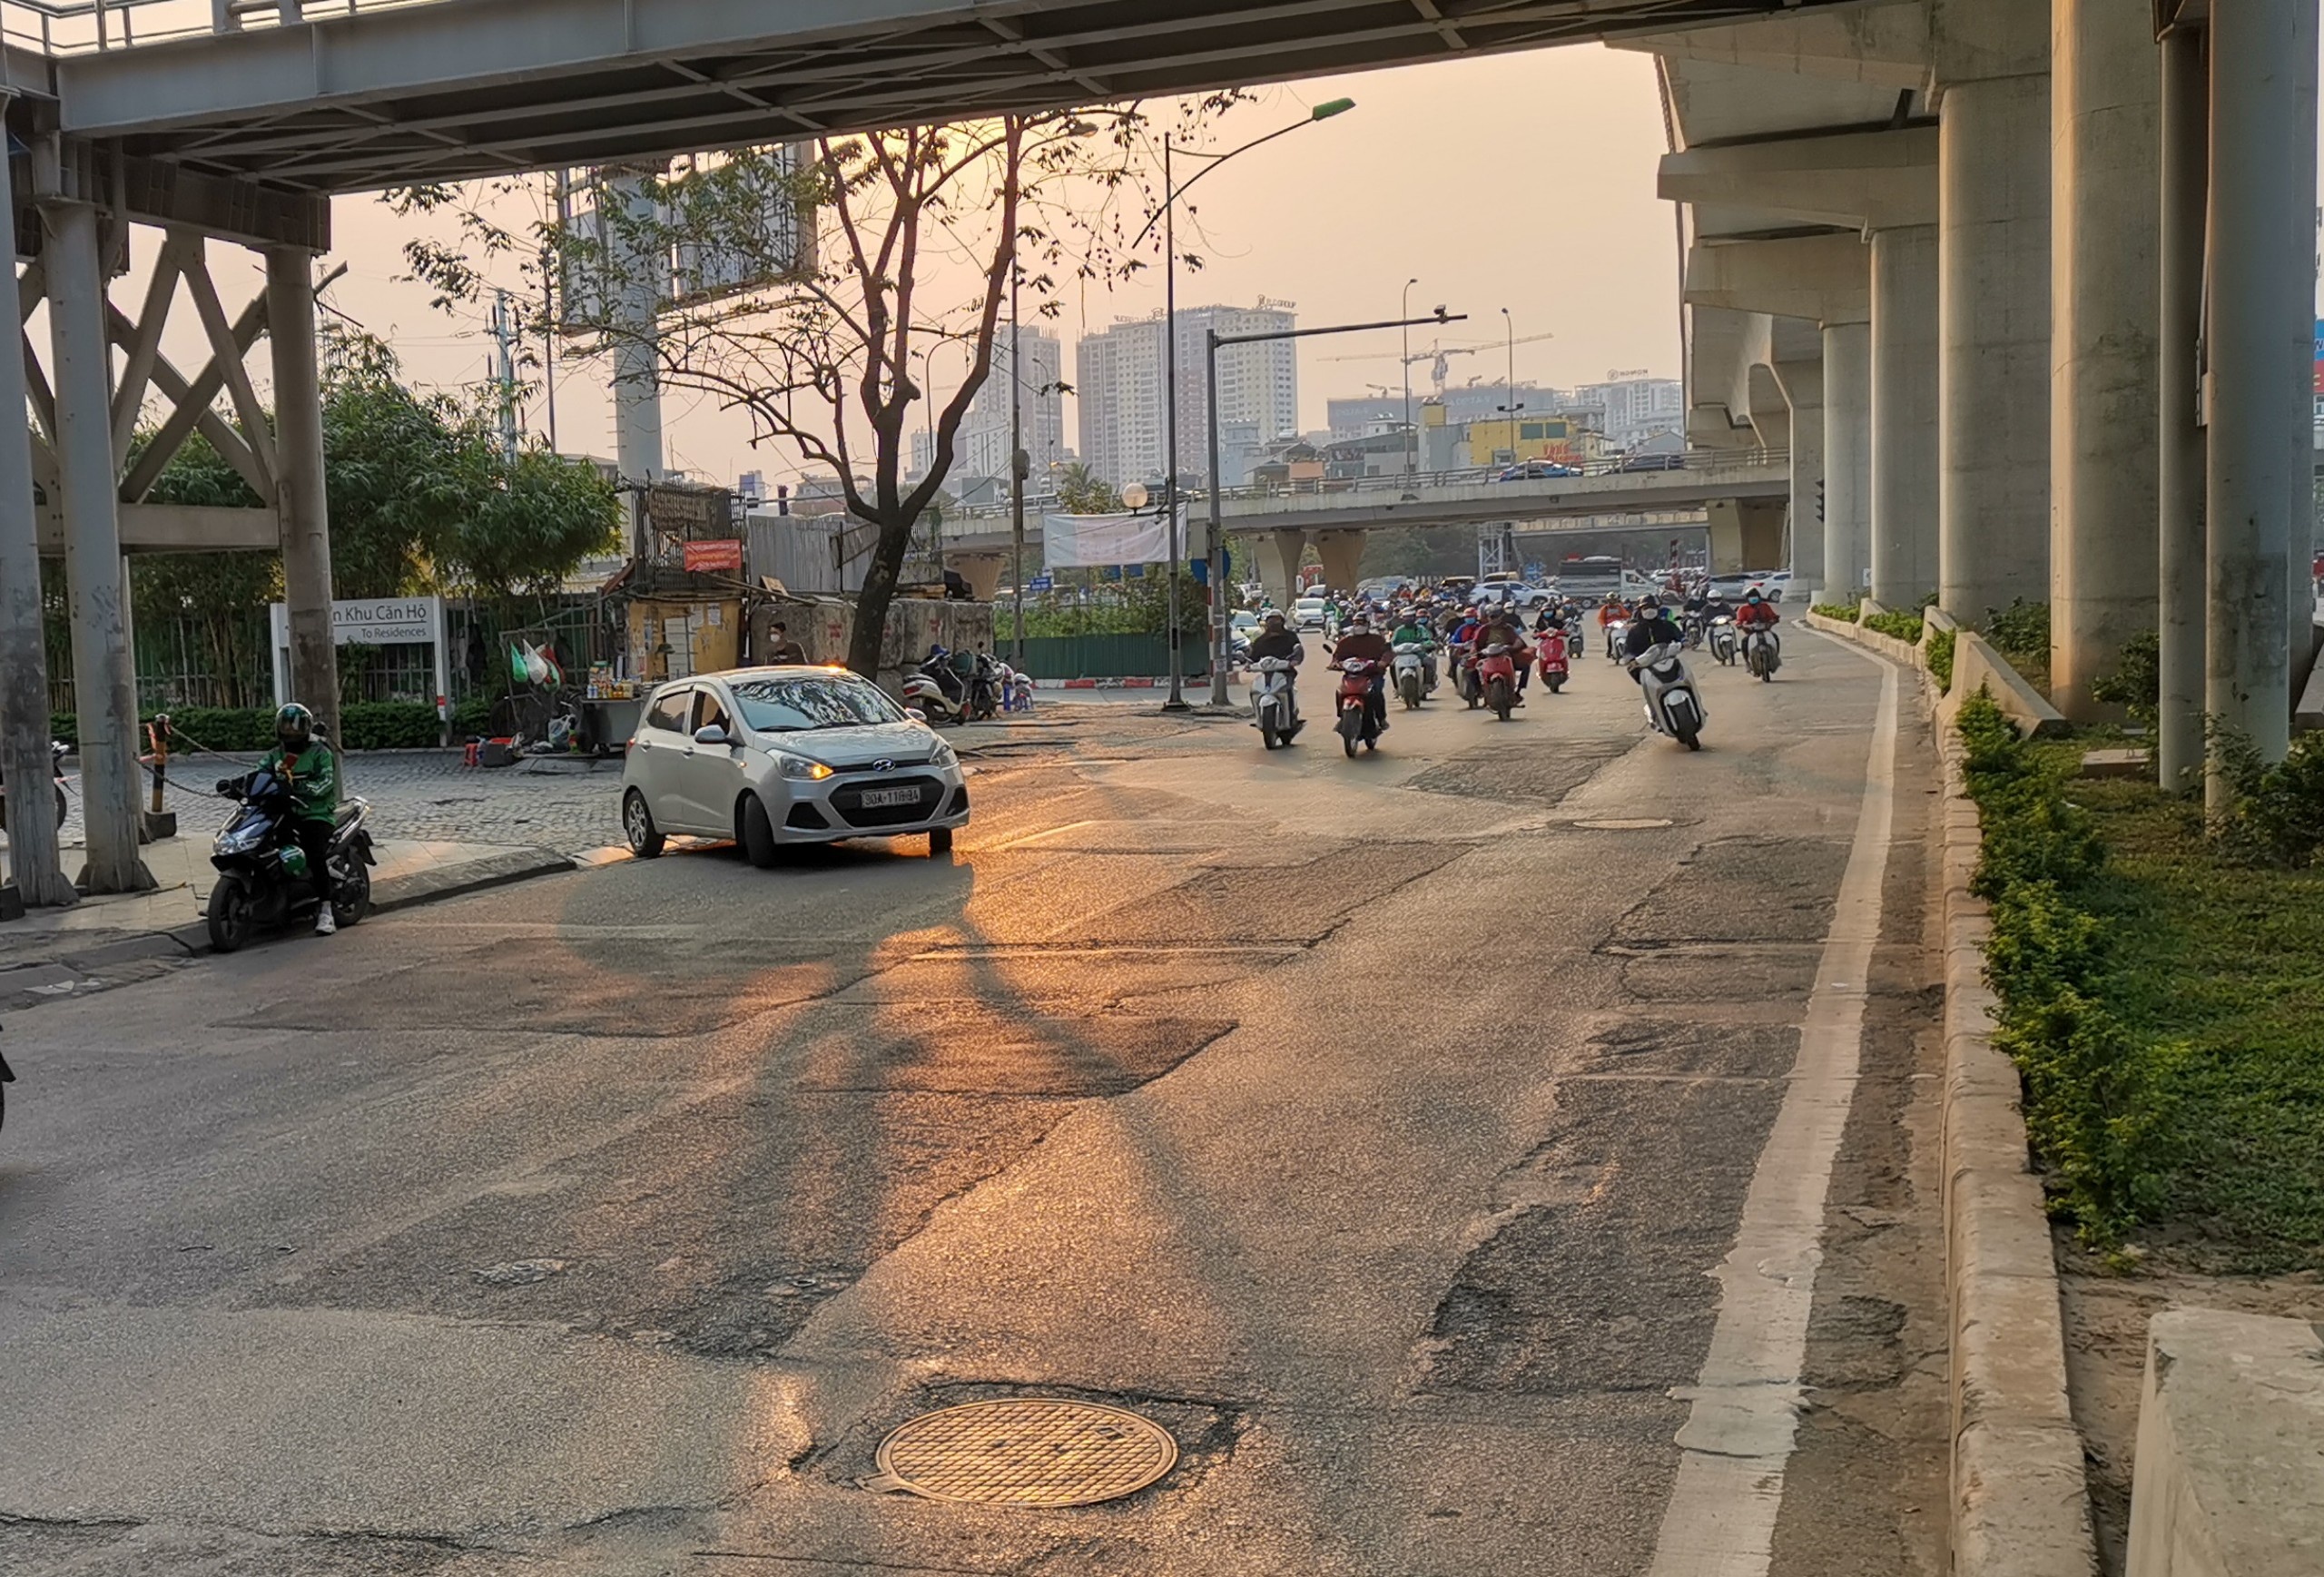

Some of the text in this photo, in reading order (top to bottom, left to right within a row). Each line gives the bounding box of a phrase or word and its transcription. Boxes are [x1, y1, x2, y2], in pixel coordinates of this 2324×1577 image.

[346, 606, 372, 621] Khu
[376, 605, 402, 620] Căn
[407, 604, 427, 621] Hộ
[362, 626, 427, 638] To Residences
